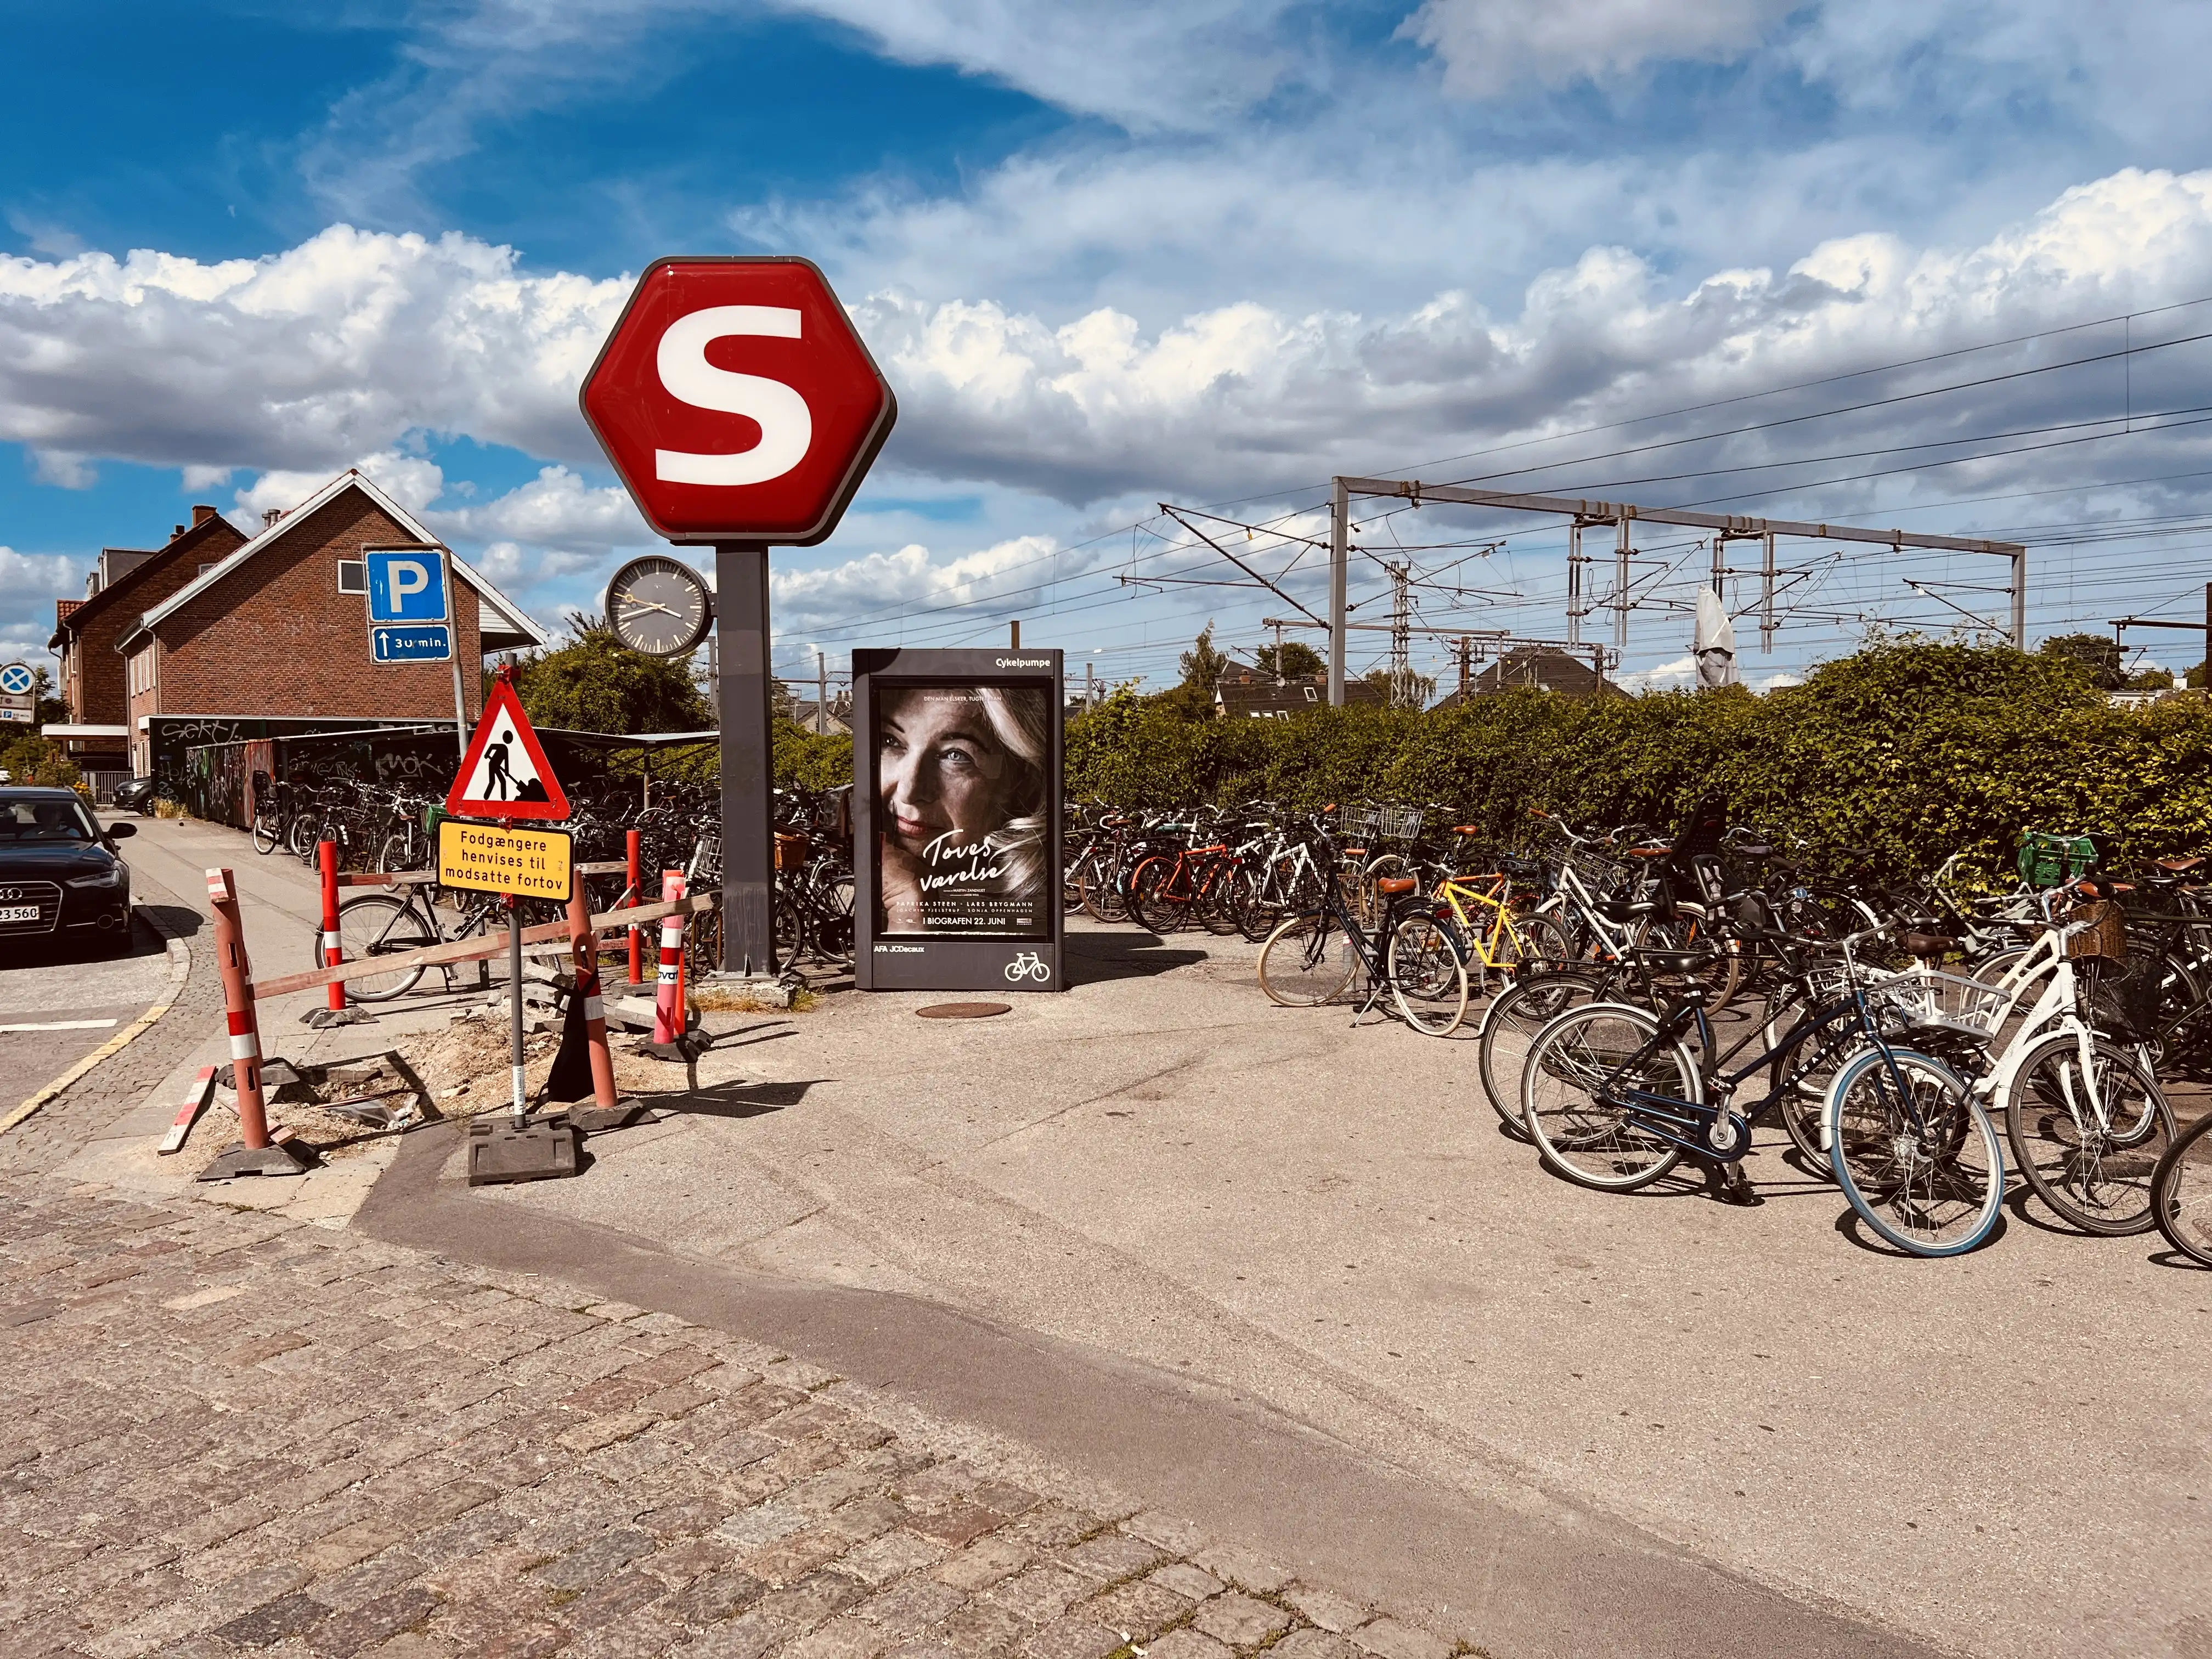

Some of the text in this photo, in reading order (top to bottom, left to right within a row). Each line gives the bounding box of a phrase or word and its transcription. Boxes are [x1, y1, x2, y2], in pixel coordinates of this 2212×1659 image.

[655, 305, 812, 486] S
[387, 561, 429, 613] P
[395, 638, 446, 648] 30 min.
[995, 658, 1051, 668] Cykelpumpe
[461, 831, 546, 851] Fodgængere
[923, 829, 991, 866] Toves
[462, 849, 523, 867] henvises
[530, 857, 545, 870] til
[445, 868, 562, 890] modsatte fortov
[920, 856, 1013, 891] værelse
[14, 908, 37, 918] 560
[1791, 1048, 1826, 1081] SWAP
